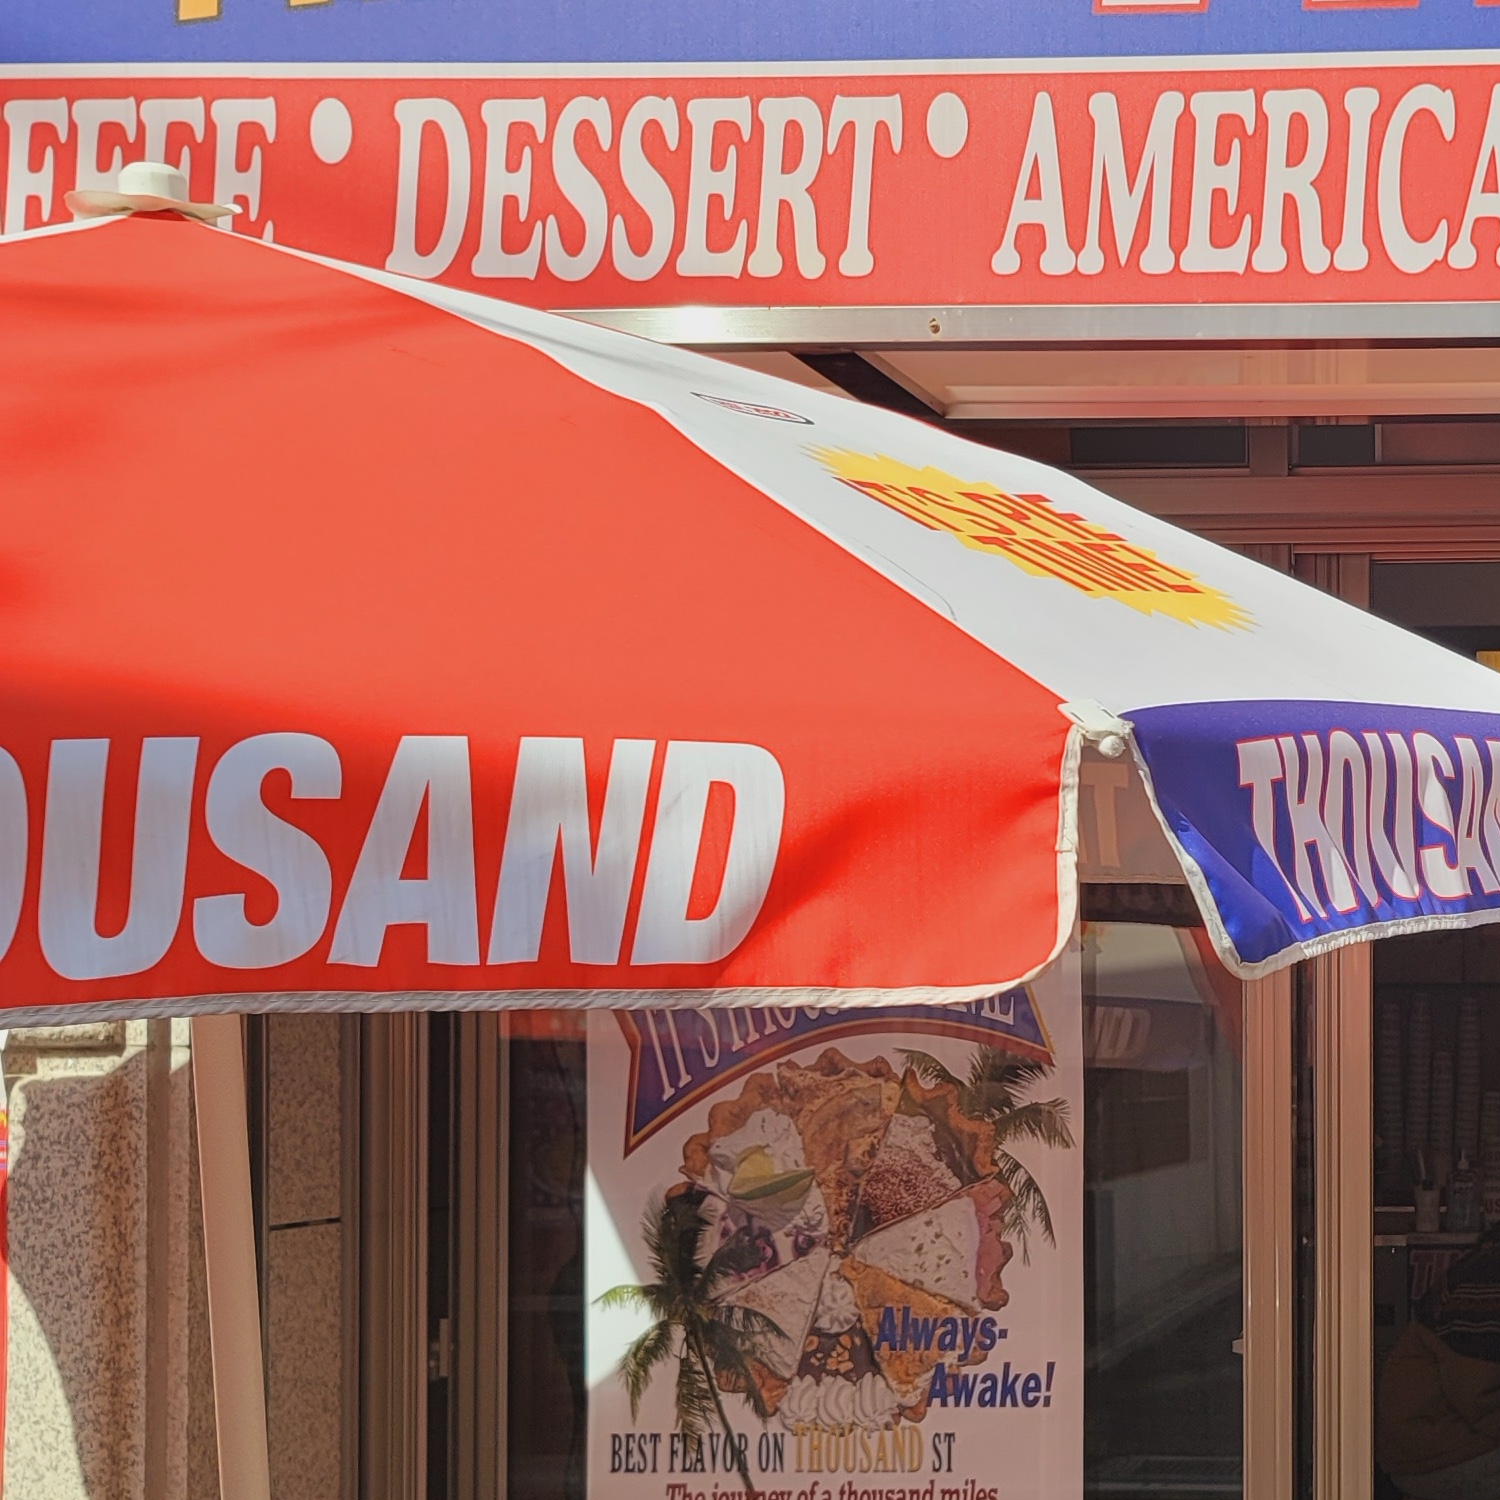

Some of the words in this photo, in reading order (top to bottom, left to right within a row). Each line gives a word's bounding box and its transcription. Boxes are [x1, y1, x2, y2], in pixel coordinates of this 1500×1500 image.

[386, 93, 902, 282] DESSERT
[0, 731, 786, 981] USAND
[873, 1306, 1009, 1362] Always-
[926, 1361, 1056, 1408] Awake!
[610, 1432, 662, 1473] BEST
[668, 1432, 750, 1473] FLAVOR
[758, 1432, 785, 1473] ON
[794, 1424, 924, 1473] THOUSAND
[932, 1432, 956, 1473] ST
